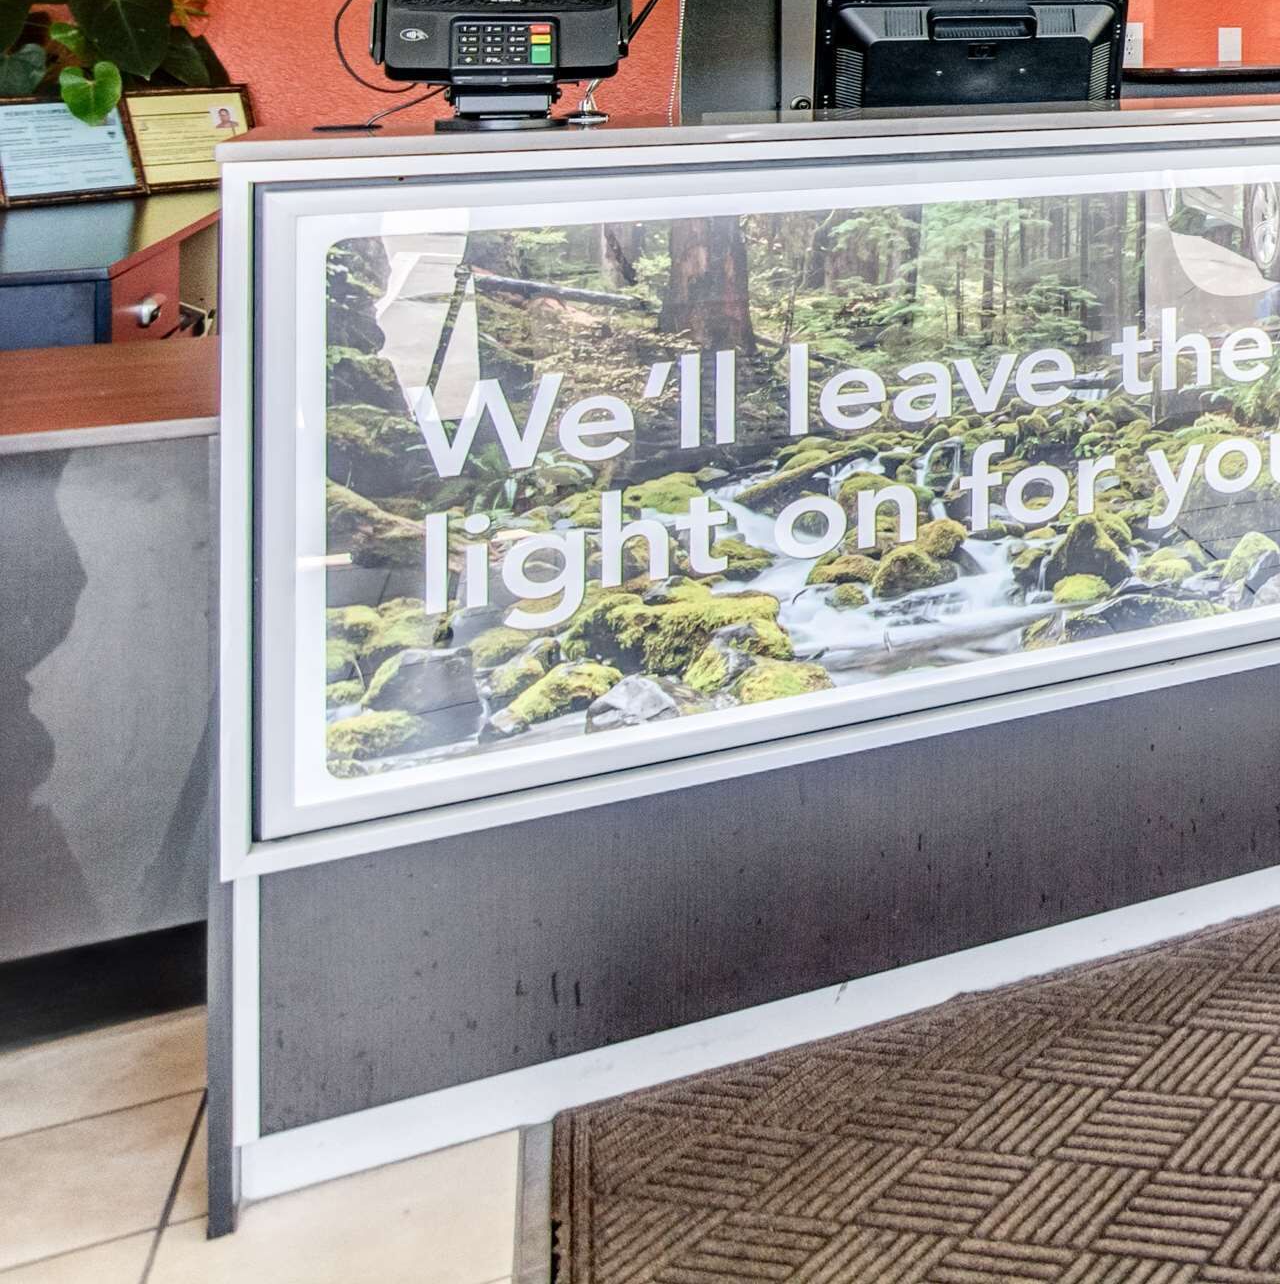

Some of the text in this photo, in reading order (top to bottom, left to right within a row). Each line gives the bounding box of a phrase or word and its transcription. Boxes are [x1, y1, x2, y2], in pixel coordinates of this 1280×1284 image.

[788, 342, 1077, 436] leave
[1111, 307, 1273, 394] the
[424, 488, 730, 630] light
[774, 486, 917, 560] on
[959, 438, 1119, 532] for
